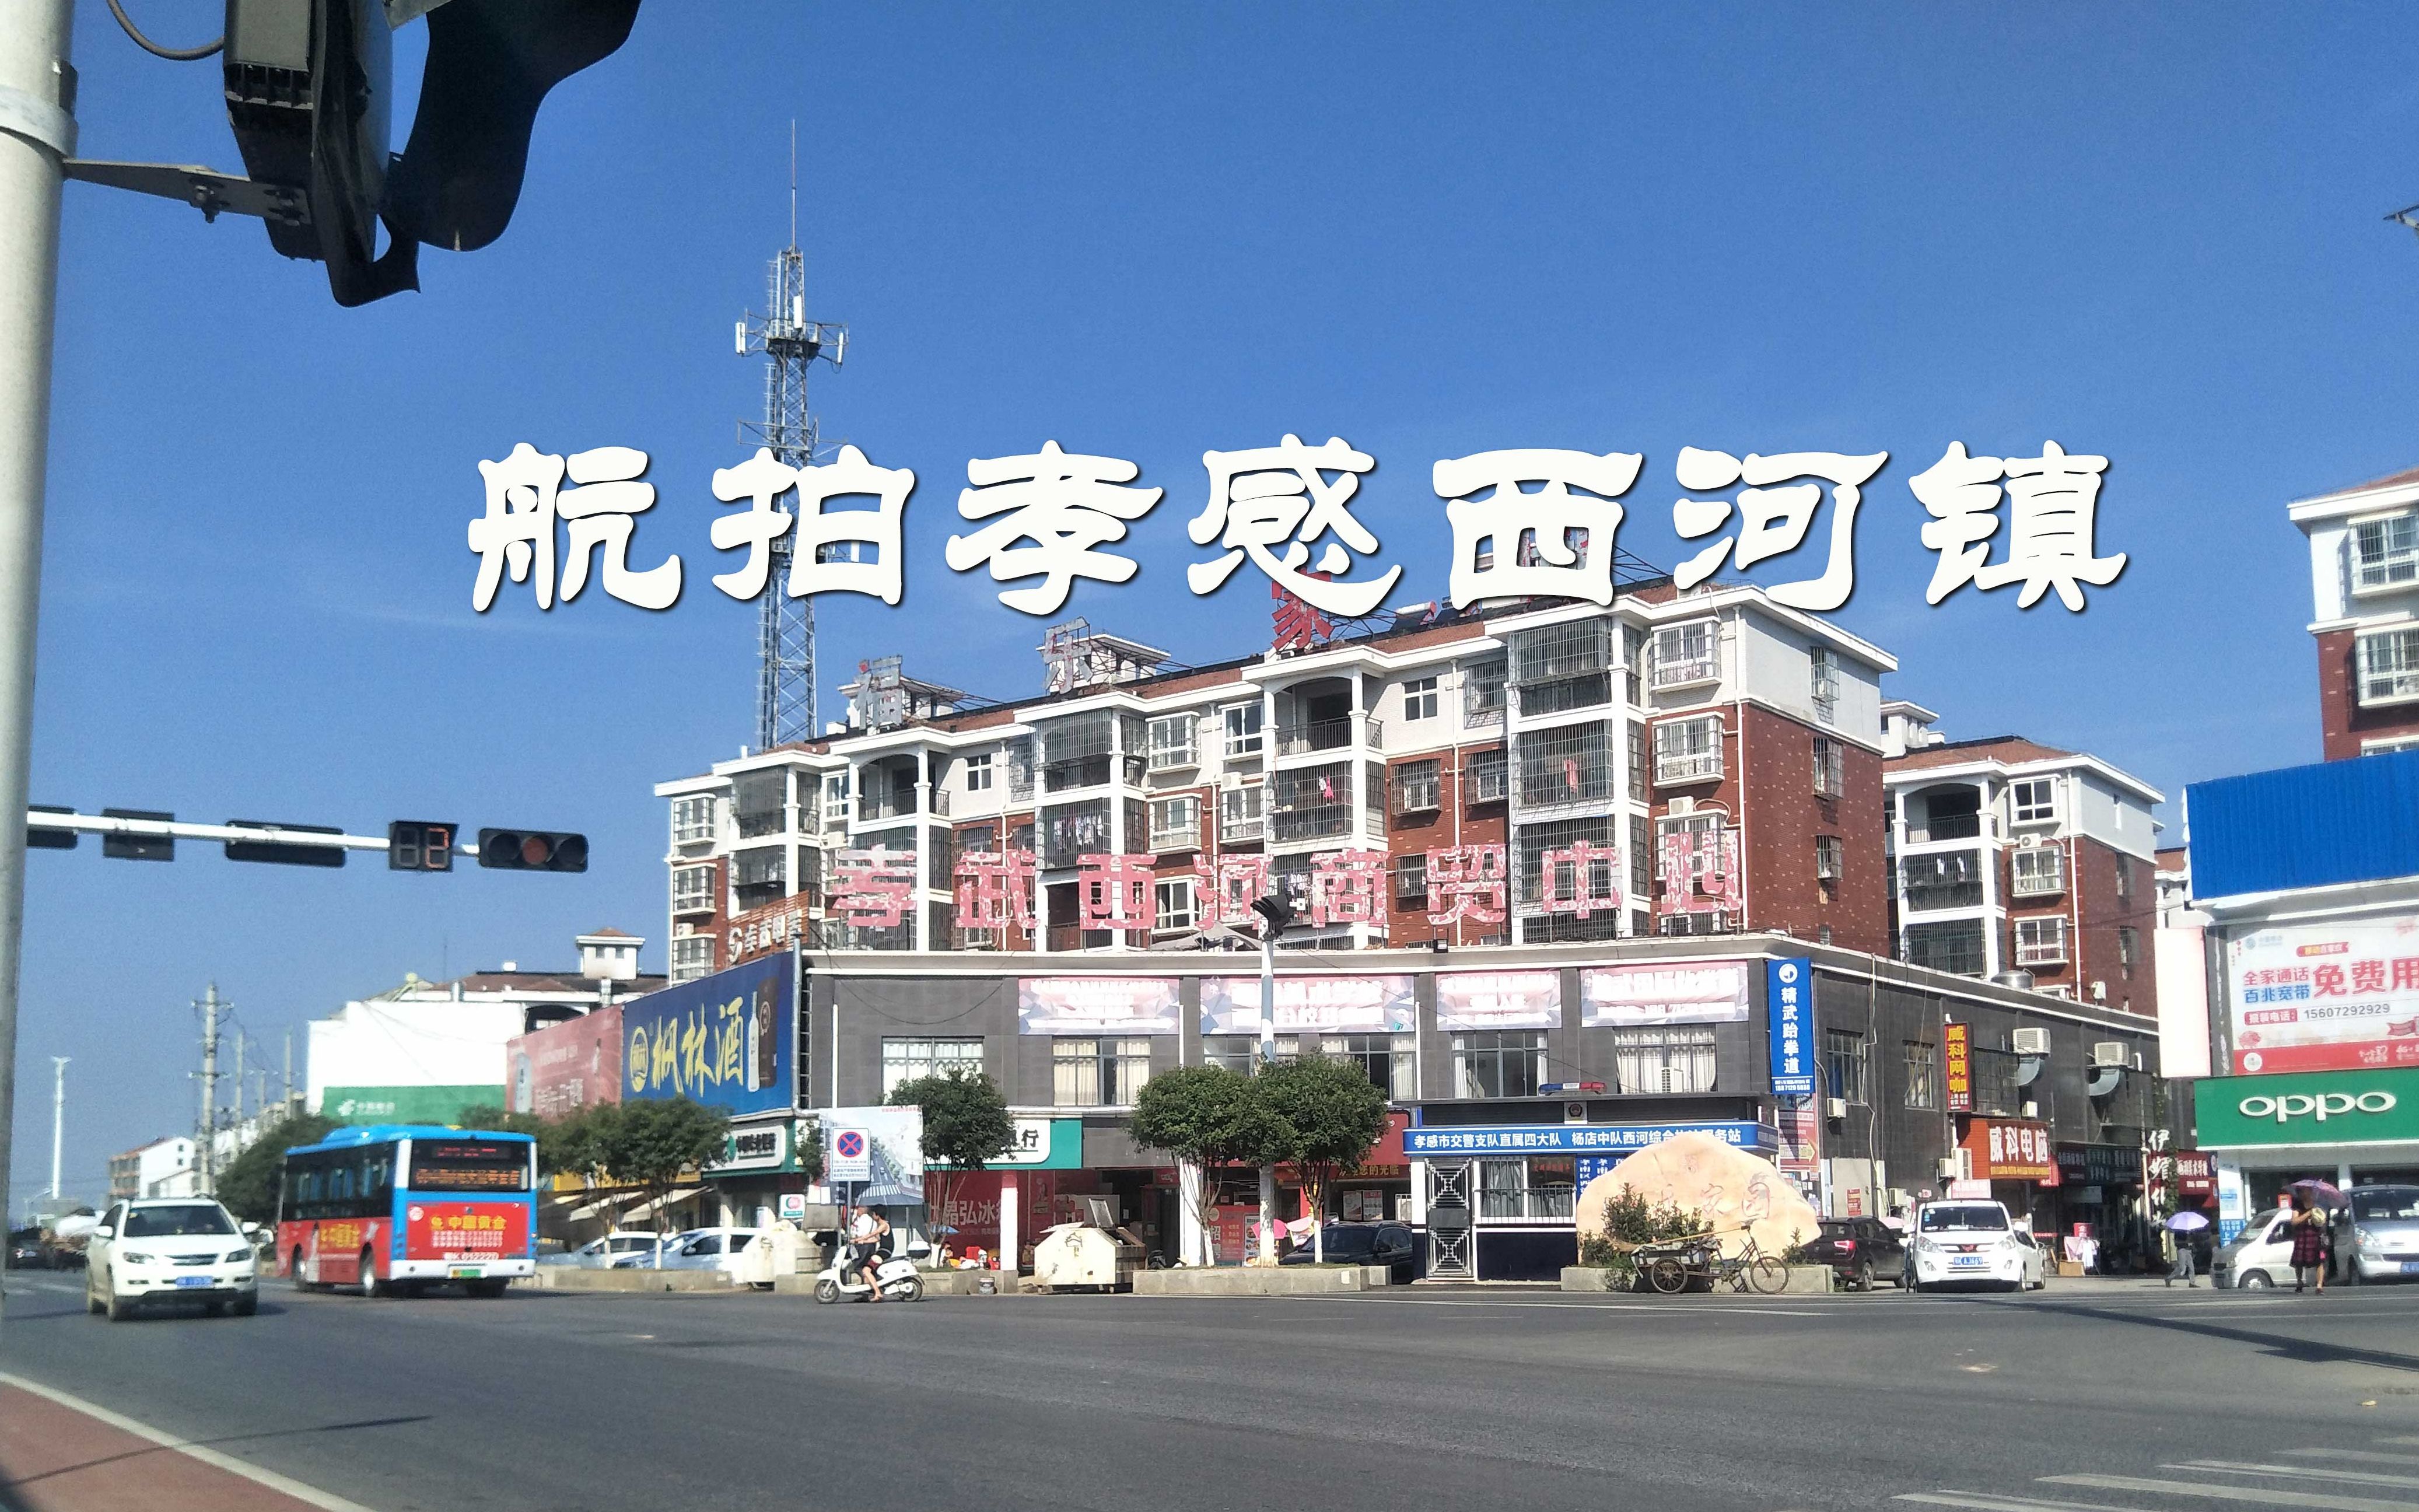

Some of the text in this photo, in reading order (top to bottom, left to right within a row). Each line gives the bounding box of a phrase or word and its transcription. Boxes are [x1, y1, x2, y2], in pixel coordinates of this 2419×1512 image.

[2243, 967, 2309, 986] 全家通话
[2243, 984, 2311, 1005] 百兆宽带
[2304, 1003, 2390, 1019] 15607292929
[1781, 986, 1801, 1074] 精武跆拳道
[1947, 1025, 1968, 1093] 威科网咖
[1414, 1128, 1741, 1149] 孝感市交警支队直属四大队 杨店中队西河综合服务站
[943, 1199, 1001, 1227] 晶弘冰
